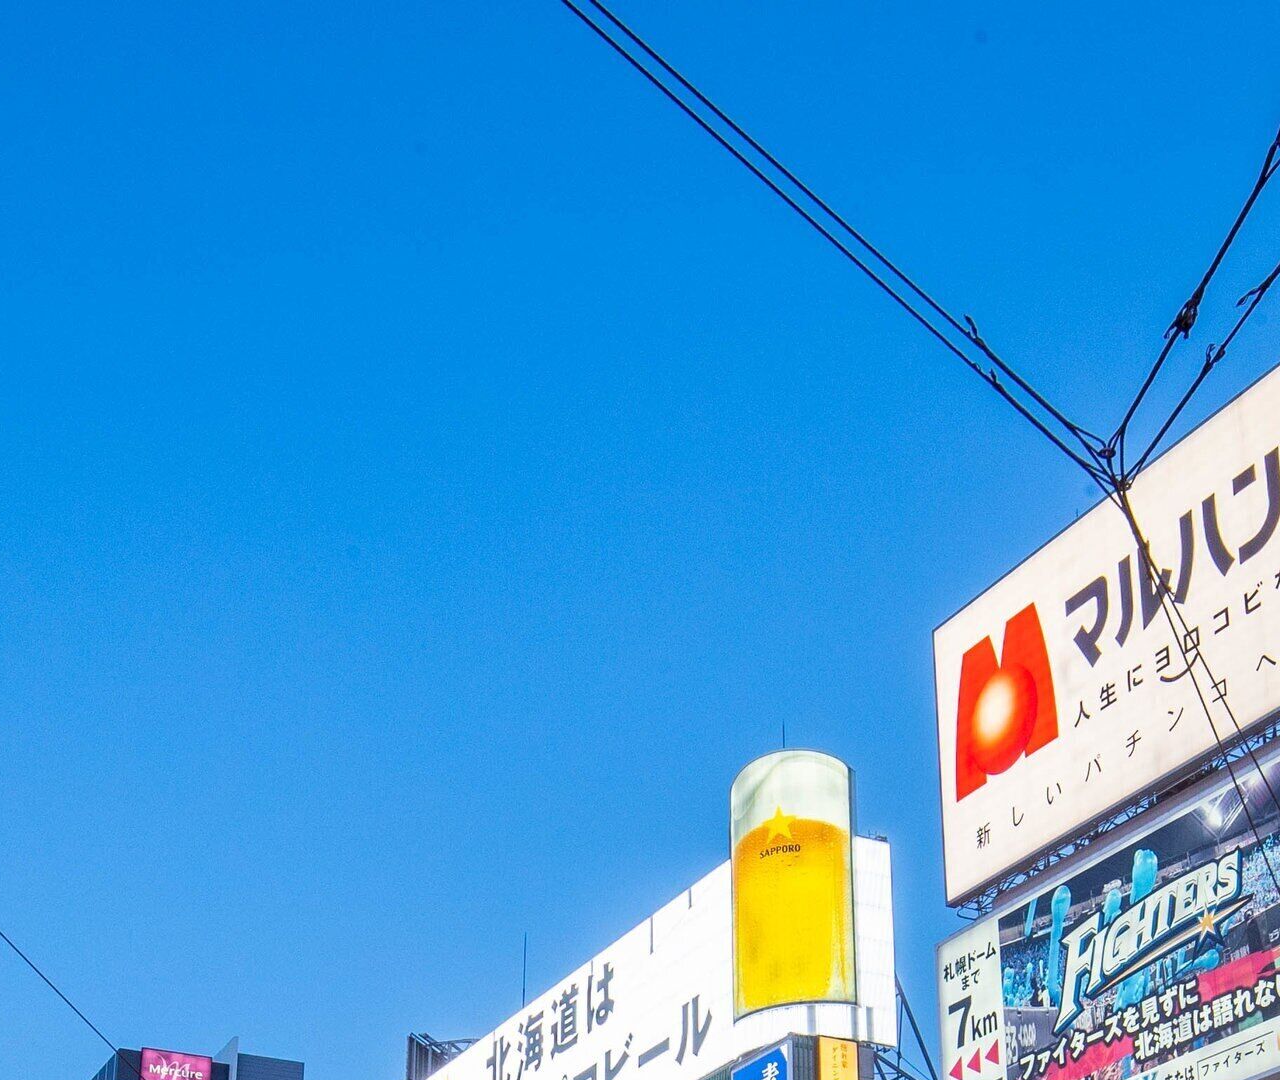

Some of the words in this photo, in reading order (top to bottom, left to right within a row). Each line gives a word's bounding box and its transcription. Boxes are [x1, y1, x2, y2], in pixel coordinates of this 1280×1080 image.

[975, 653, 1277, 850] 新しいパチンコへ
[759, 843, 802, 859] SAPPORO
[1054, 847, 1243, 1036] FIGHTERS
[943, 942, 997, 983] 札幌ドーム
[960, 968, 981, 991] まで
[948, 995, 998, 1048] 7km
[1020, 979, 1199, 1080] ファイターズを見ずに
[149, 1063, 204, 1080] Mercure
[1201, 1042, 1265, 1077] ファイターズ
